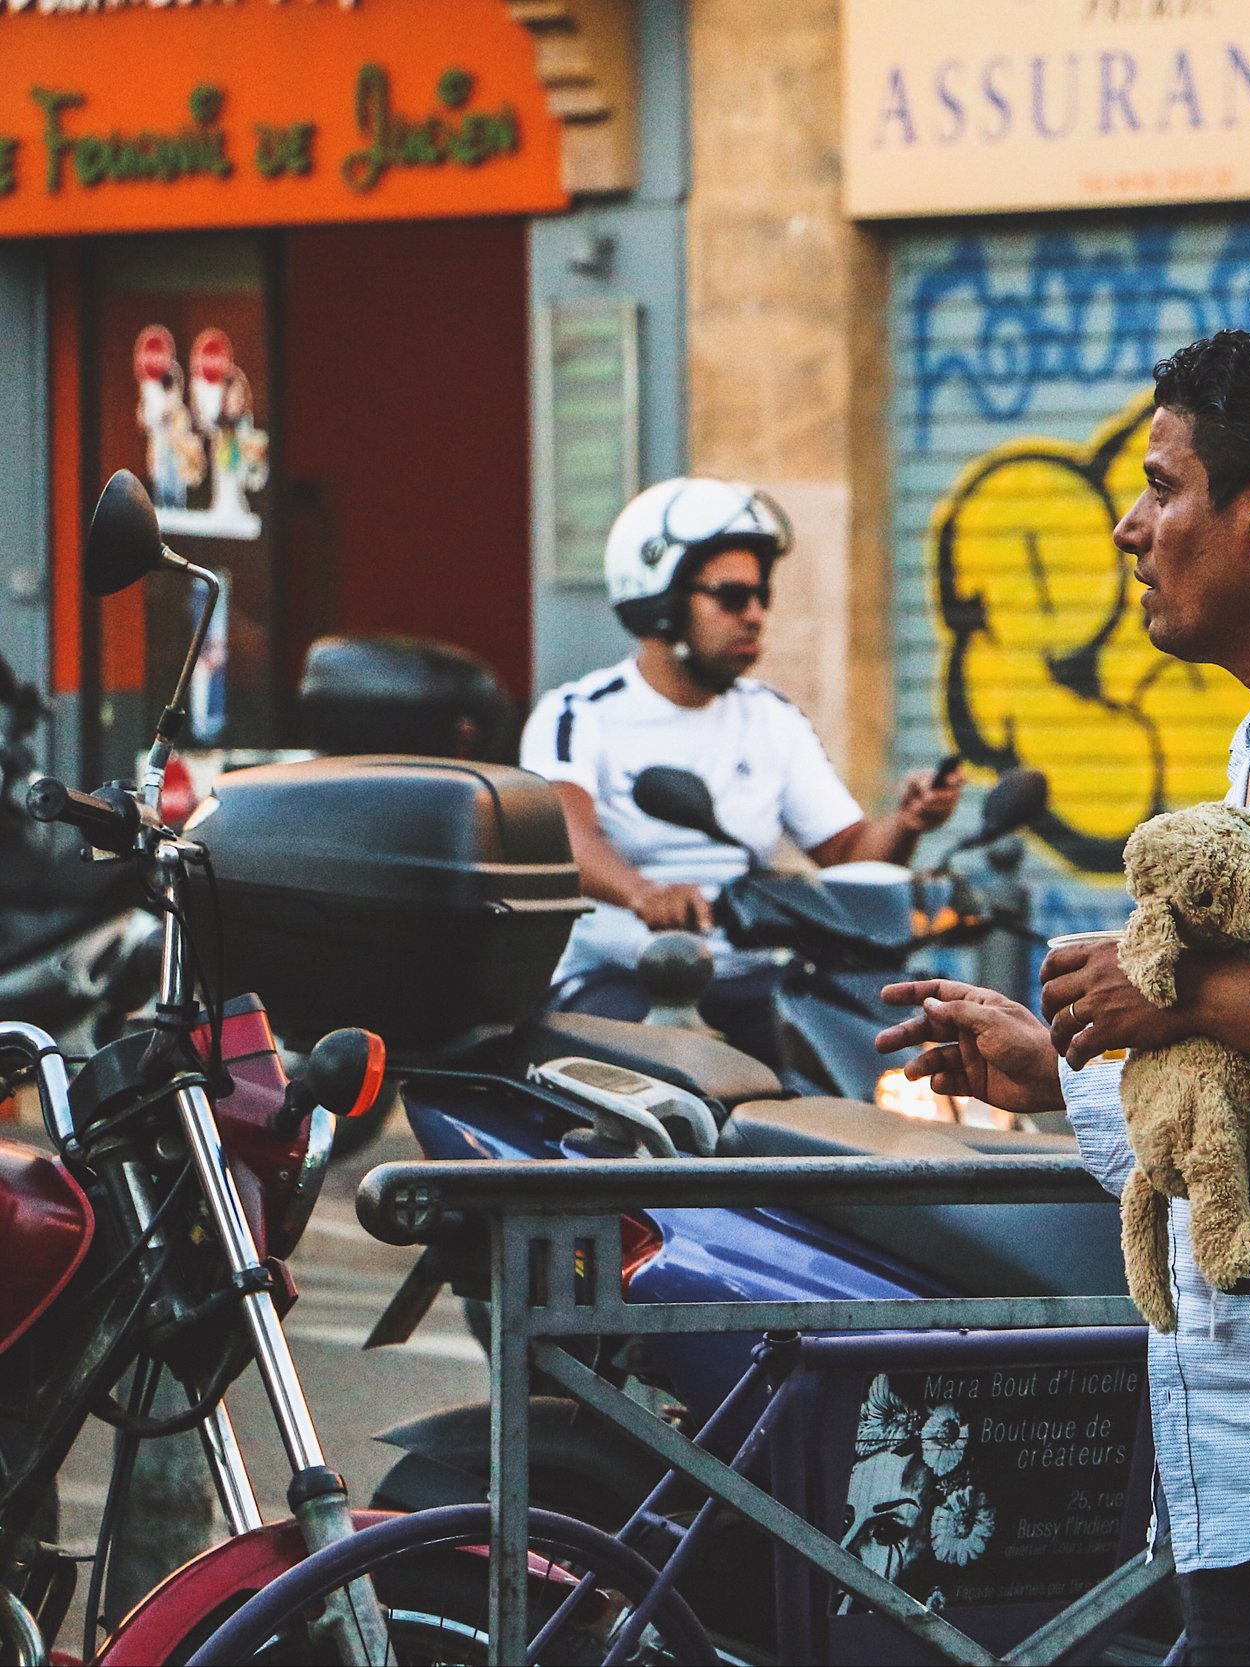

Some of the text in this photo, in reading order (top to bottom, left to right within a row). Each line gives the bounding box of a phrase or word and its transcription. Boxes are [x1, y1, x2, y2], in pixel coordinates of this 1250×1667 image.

[924, 1375, 980, 1400] Mara
[991, 1372, 1038, 1398] Bout
[981, 1412, 1112, 1447] Boutique de
[1017, 1442, 1127, 1470] créateurs
[1067, 1489, 1125, 1512] 25, rue
[1017, 1517, 1062, 1544] Bussy
